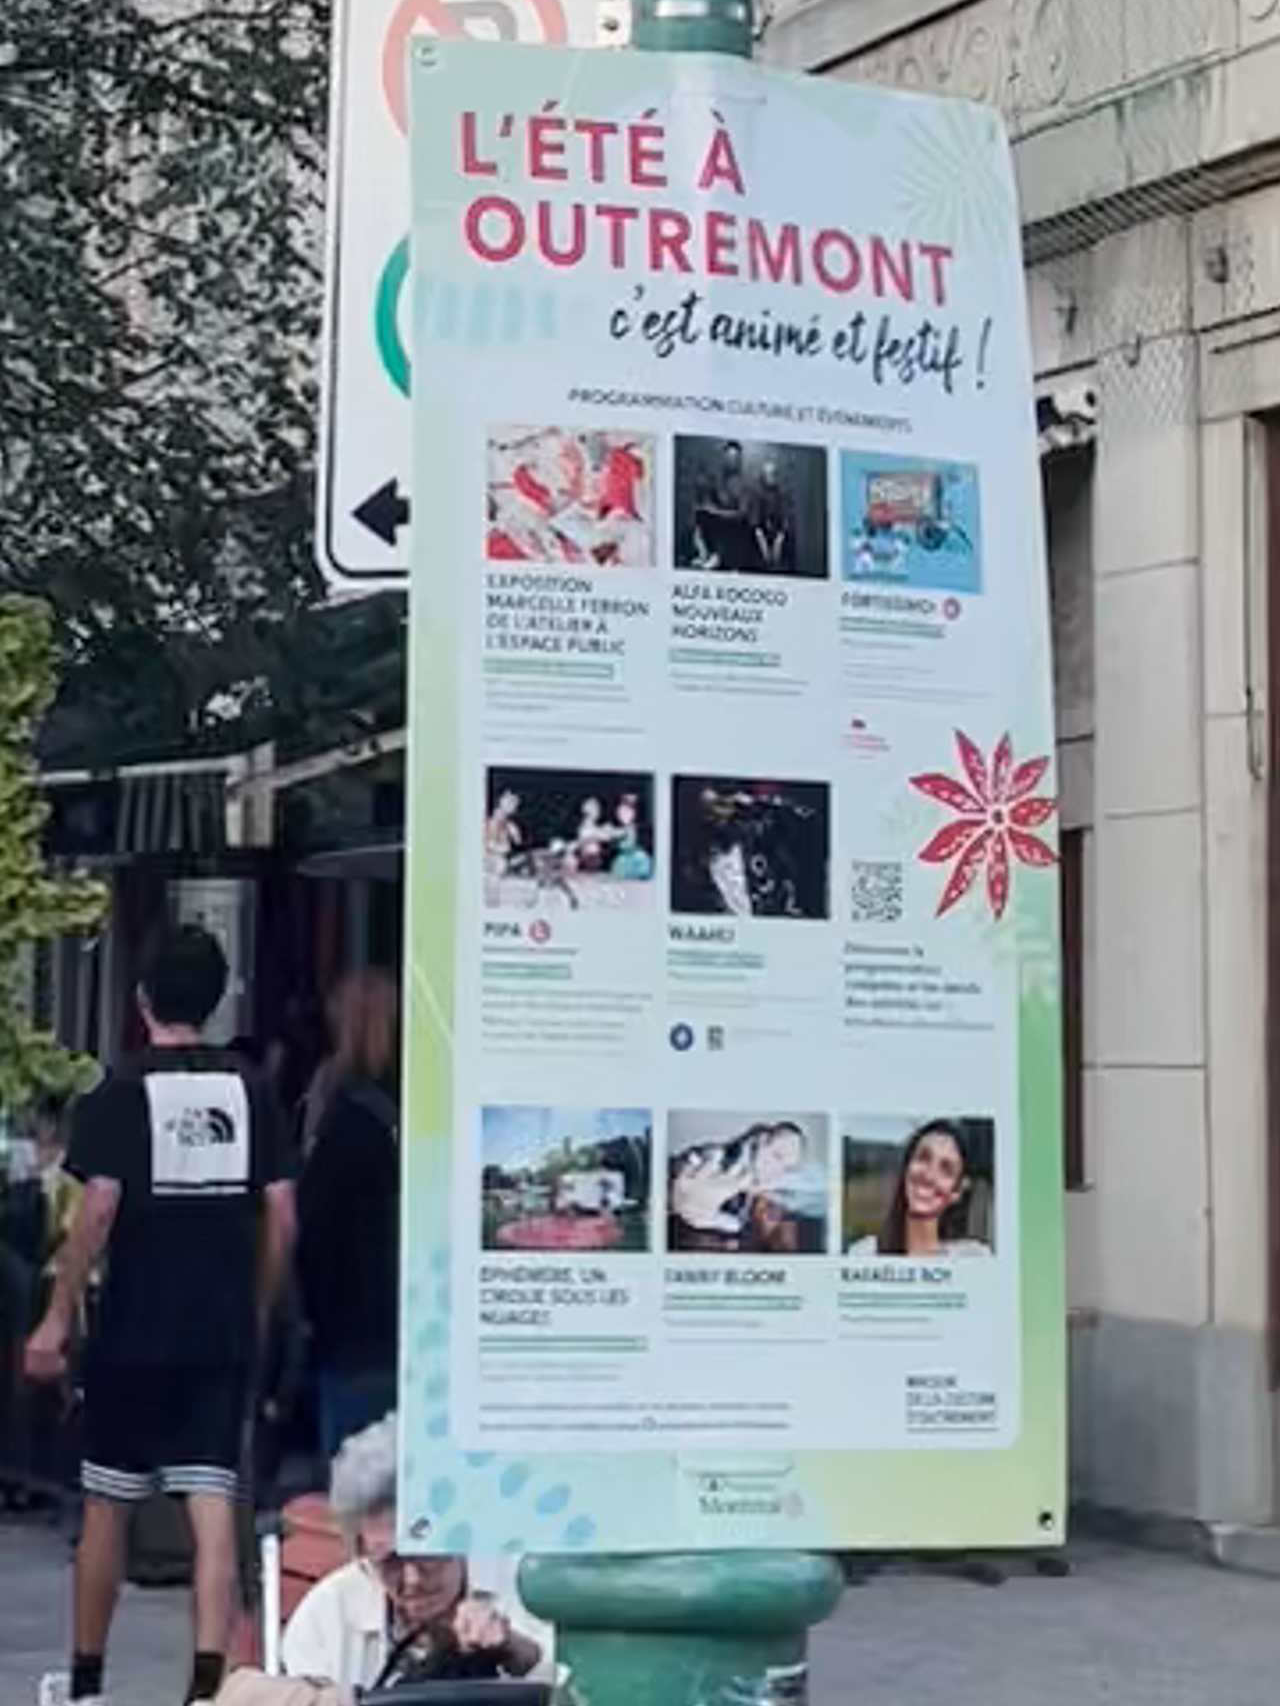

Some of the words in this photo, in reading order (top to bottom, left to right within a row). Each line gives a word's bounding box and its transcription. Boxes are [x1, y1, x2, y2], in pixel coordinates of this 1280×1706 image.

[460, 99, 669, 188] L'ÉTÉ
[697, 109, 747, 196] À
[462, 194, 954, 307] OUTREMONT
[609, 284, 703, 359] c'est
[709, 307, 823, 358] animé
[831, 310, 869, 364] et
[870, 313, 964, 394] festif
